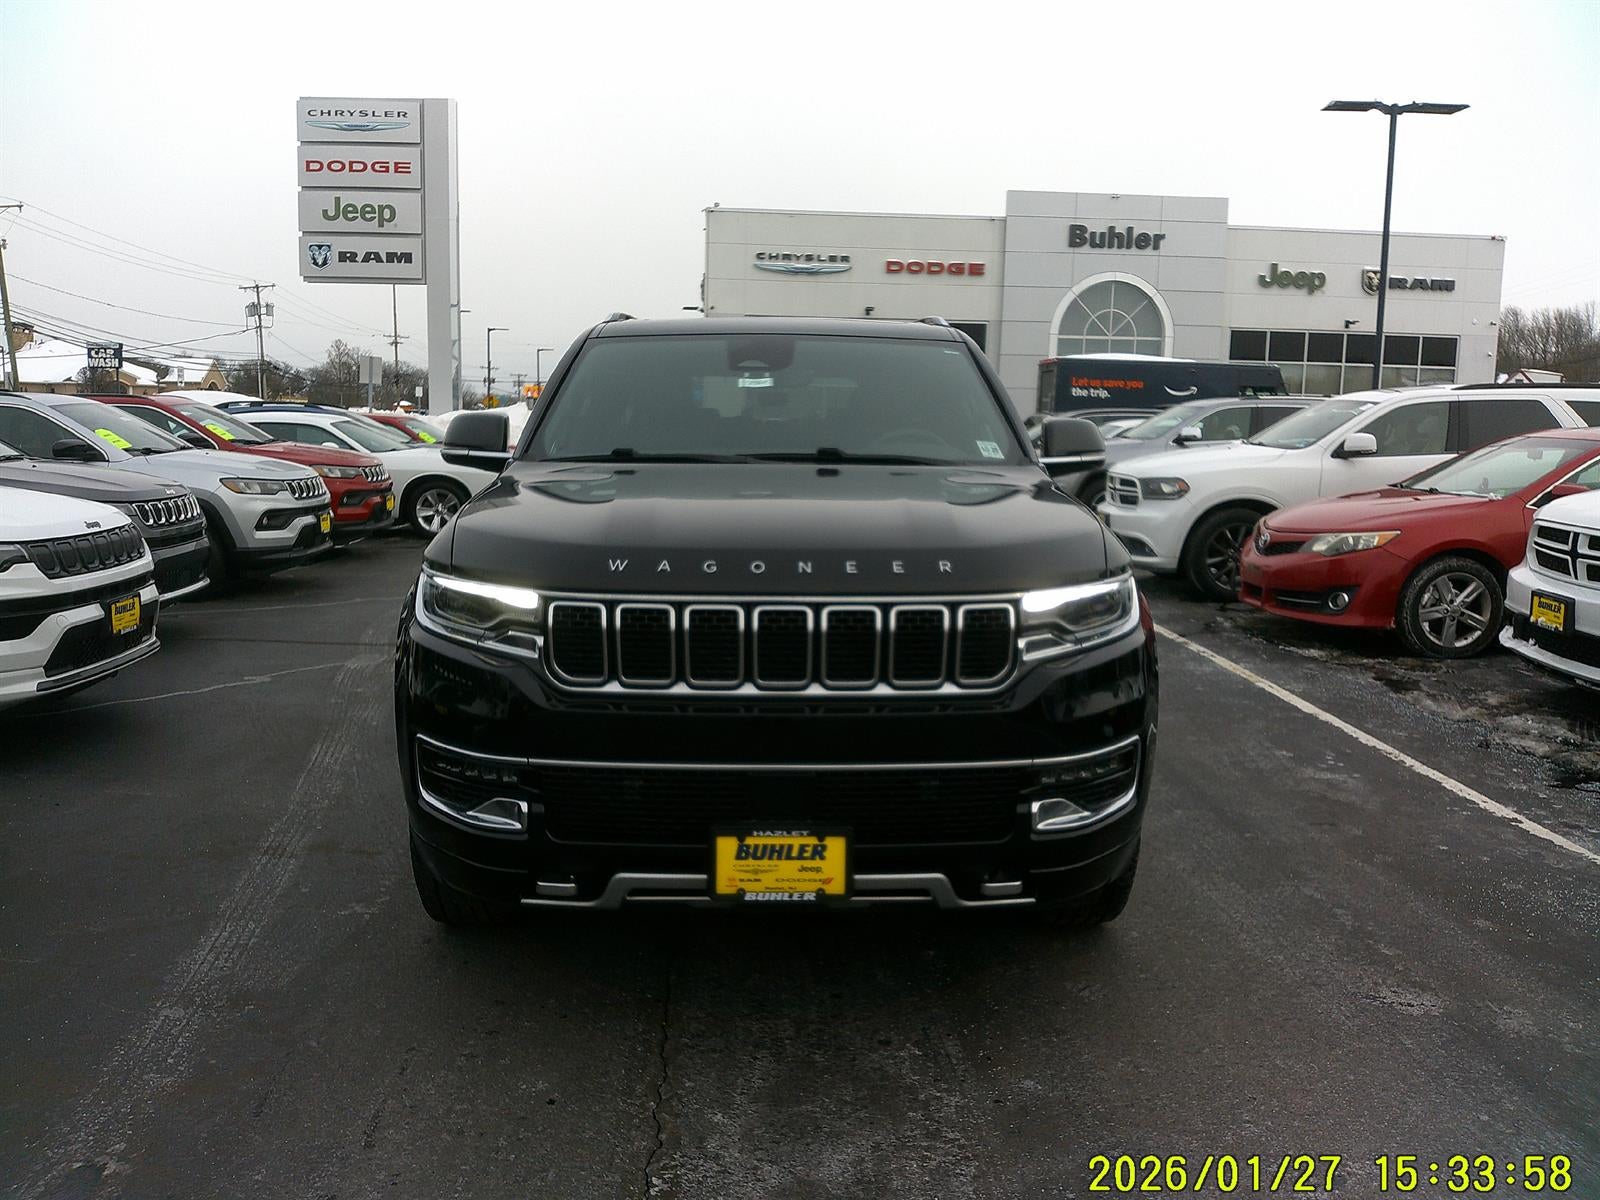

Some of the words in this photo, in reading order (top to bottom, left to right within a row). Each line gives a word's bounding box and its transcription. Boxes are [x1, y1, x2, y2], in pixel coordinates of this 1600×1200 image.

[307, 109, 408, 118] CHRYSLER
[305, 160, 412, 174] DODGE
[321, 196, 397, 228] Jeep
[1068, 224, 1166, 251] Buhler
[338, 251, 413, 264] RAM
[756, 252, 851, 263] CHRYSLER
[885, 259, 986, 276] DODGE
[1258, 262, 1327, 294] Jeep
[1388, 275, 1456, 292] RAM
[91, 349, 115, 358] CAR
[88, 357, 119, 367] WASH
[1072, 377, 1089, 387] Let
[1090, 379, 1101, 387] us
[1103, 379, 1125, 388] save
[1126, 380, 1144, 390] you
[1072, 387, 1089, 397] the
[1090, 388, 1111, 399] trip.
[608, 559, 953, 574] WAGONEER
[115, 602, 136, 615] BUHLER
[735, 843, 826, 860] BUHLER
[798, 865, 823, 873] Jeep
[744, 892, 817, 901] BUHLER
